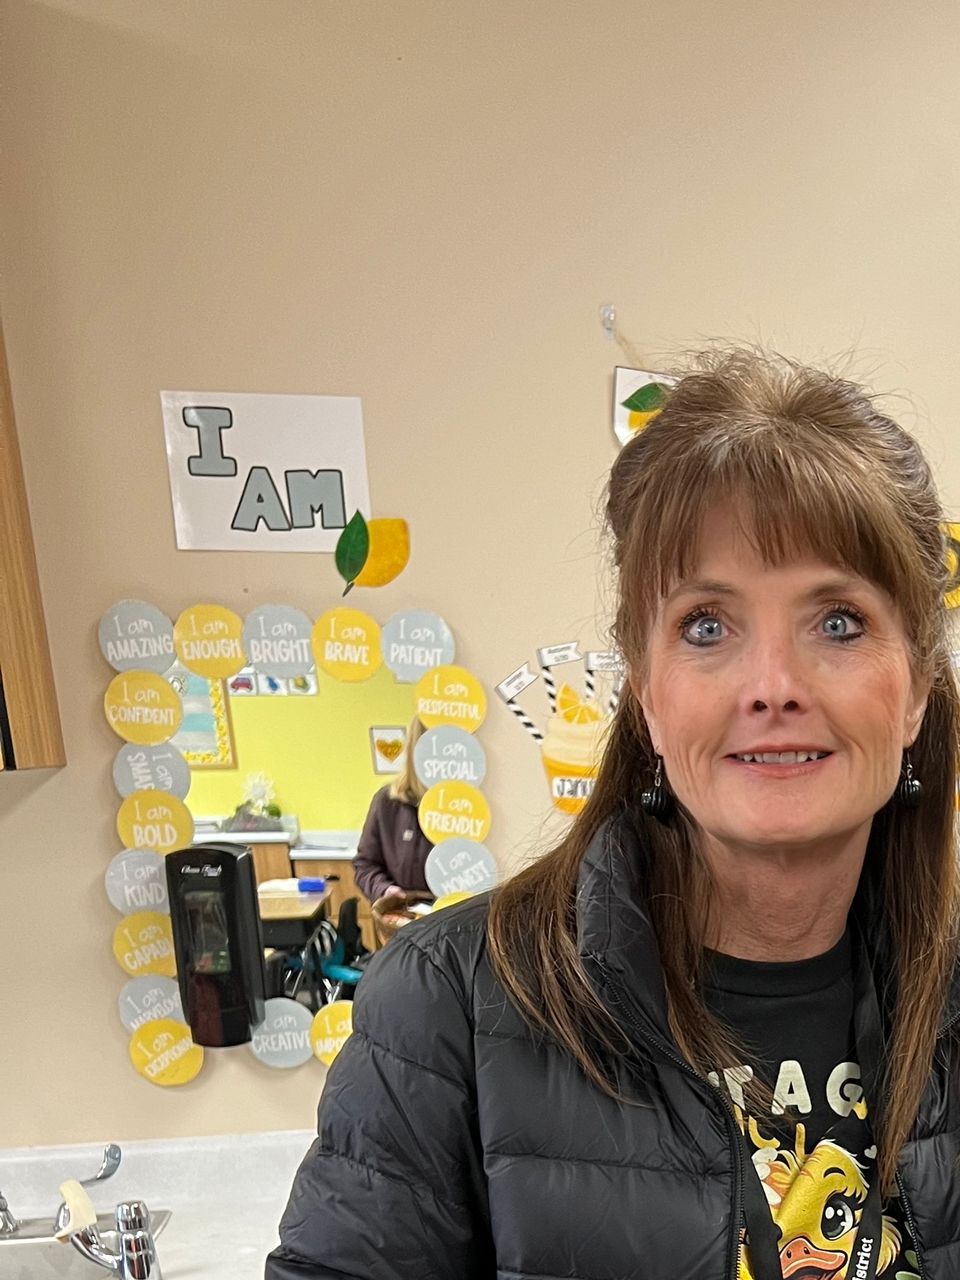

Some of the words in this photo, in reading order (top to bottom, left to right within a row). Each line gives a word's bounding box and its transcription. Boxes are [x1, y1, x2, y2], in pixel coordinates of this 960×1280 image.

[182, 406, 237, 477] I
[231, 466, 346, 532] AM
[106, 634, 174, 662] AMAZING
[181, 638, 242, 660] ENOUGH
[250, 638, 310, 664] BRIGHT
[324, 640, 369, 665] BRAVE
[423, 759, 478, 781] SPECIAL
[133, 823, 178, 847] BOLD
[424, 810, 485, 837] FRIENDLY
[124, 882, 167, 907] KIND
